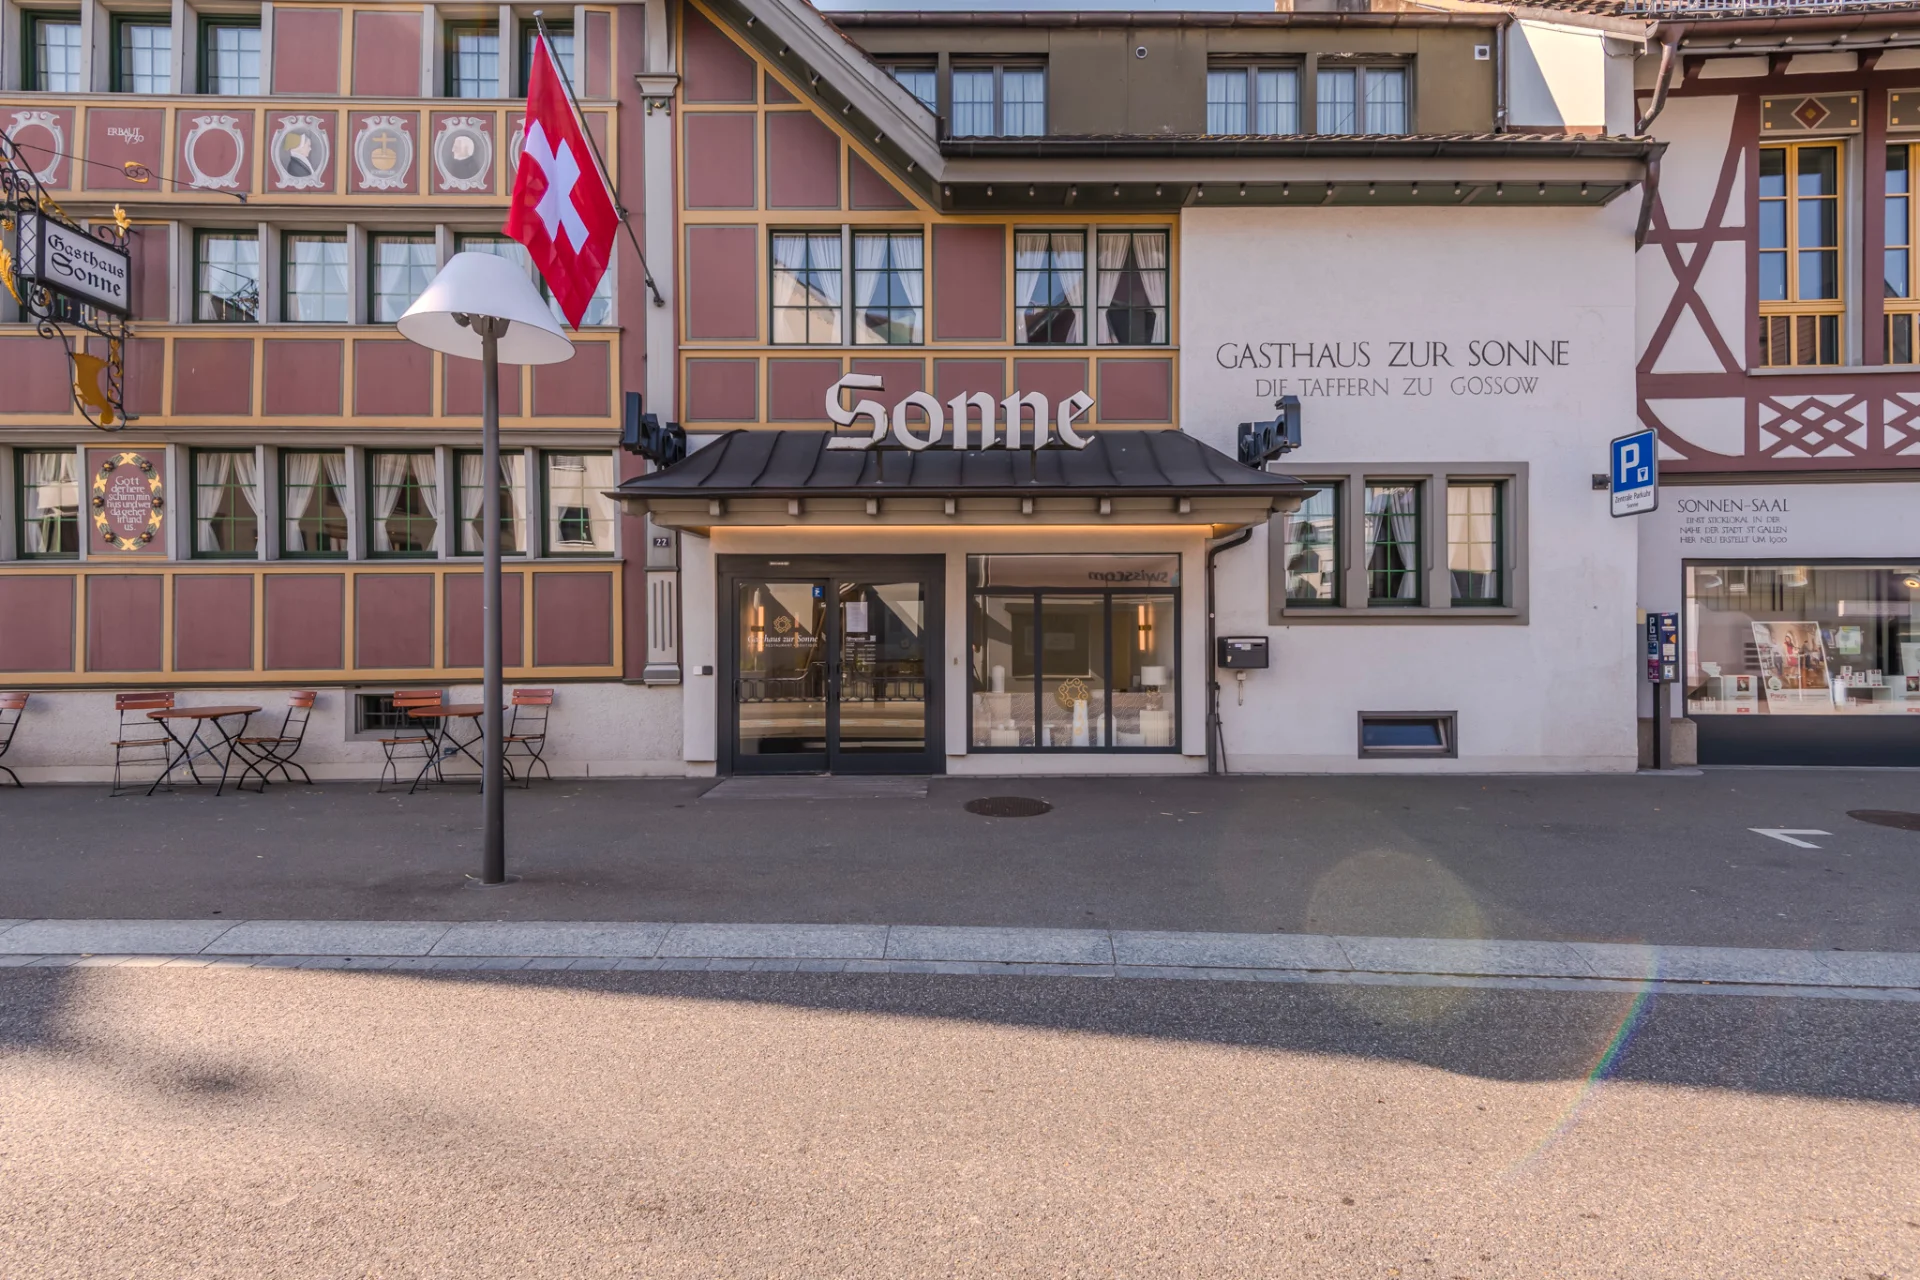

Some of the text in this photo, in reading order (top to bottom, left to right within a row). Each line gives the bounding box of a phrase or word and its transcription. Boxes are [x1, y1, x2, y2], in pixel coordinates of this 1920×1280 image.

[48, 234, 124, 278] Gasthaus
[51, 252, 121, 297] Sonne
[1216, 340, 1570, 369] GASTHAUS ZUR SONNE
[1255, 376, 1539, 397] DIE TAFFERN ZU GOSSOW
[825, 372, 1096, 451] Sonne
[1620, 443, 1640, 484] P
[115, 476, 140, 486] Gott
[111, 484, 125, 493] der
[1614, 490, 1651, 504] Zentrale Parkuhr
[106, 500, 121, 508] hus
[122, 500, 138, 508] und
[1677, 498, 1790, 513] SONNEN-SAAL
[110, 507, 121, 516] da
[1686, 516, 1706, 524] EINST
[1705, 526, 1720, 534] DER
[1721, 526, 1743, 534] STADT
[1757, 525, 1788, 534] GALLEN
[656, 538, 667, 547] 22
[1680, 536, 1788, 545] HIER NEU ERSTELLT UM 1900
[797, 634, 818, 643] Sonne
